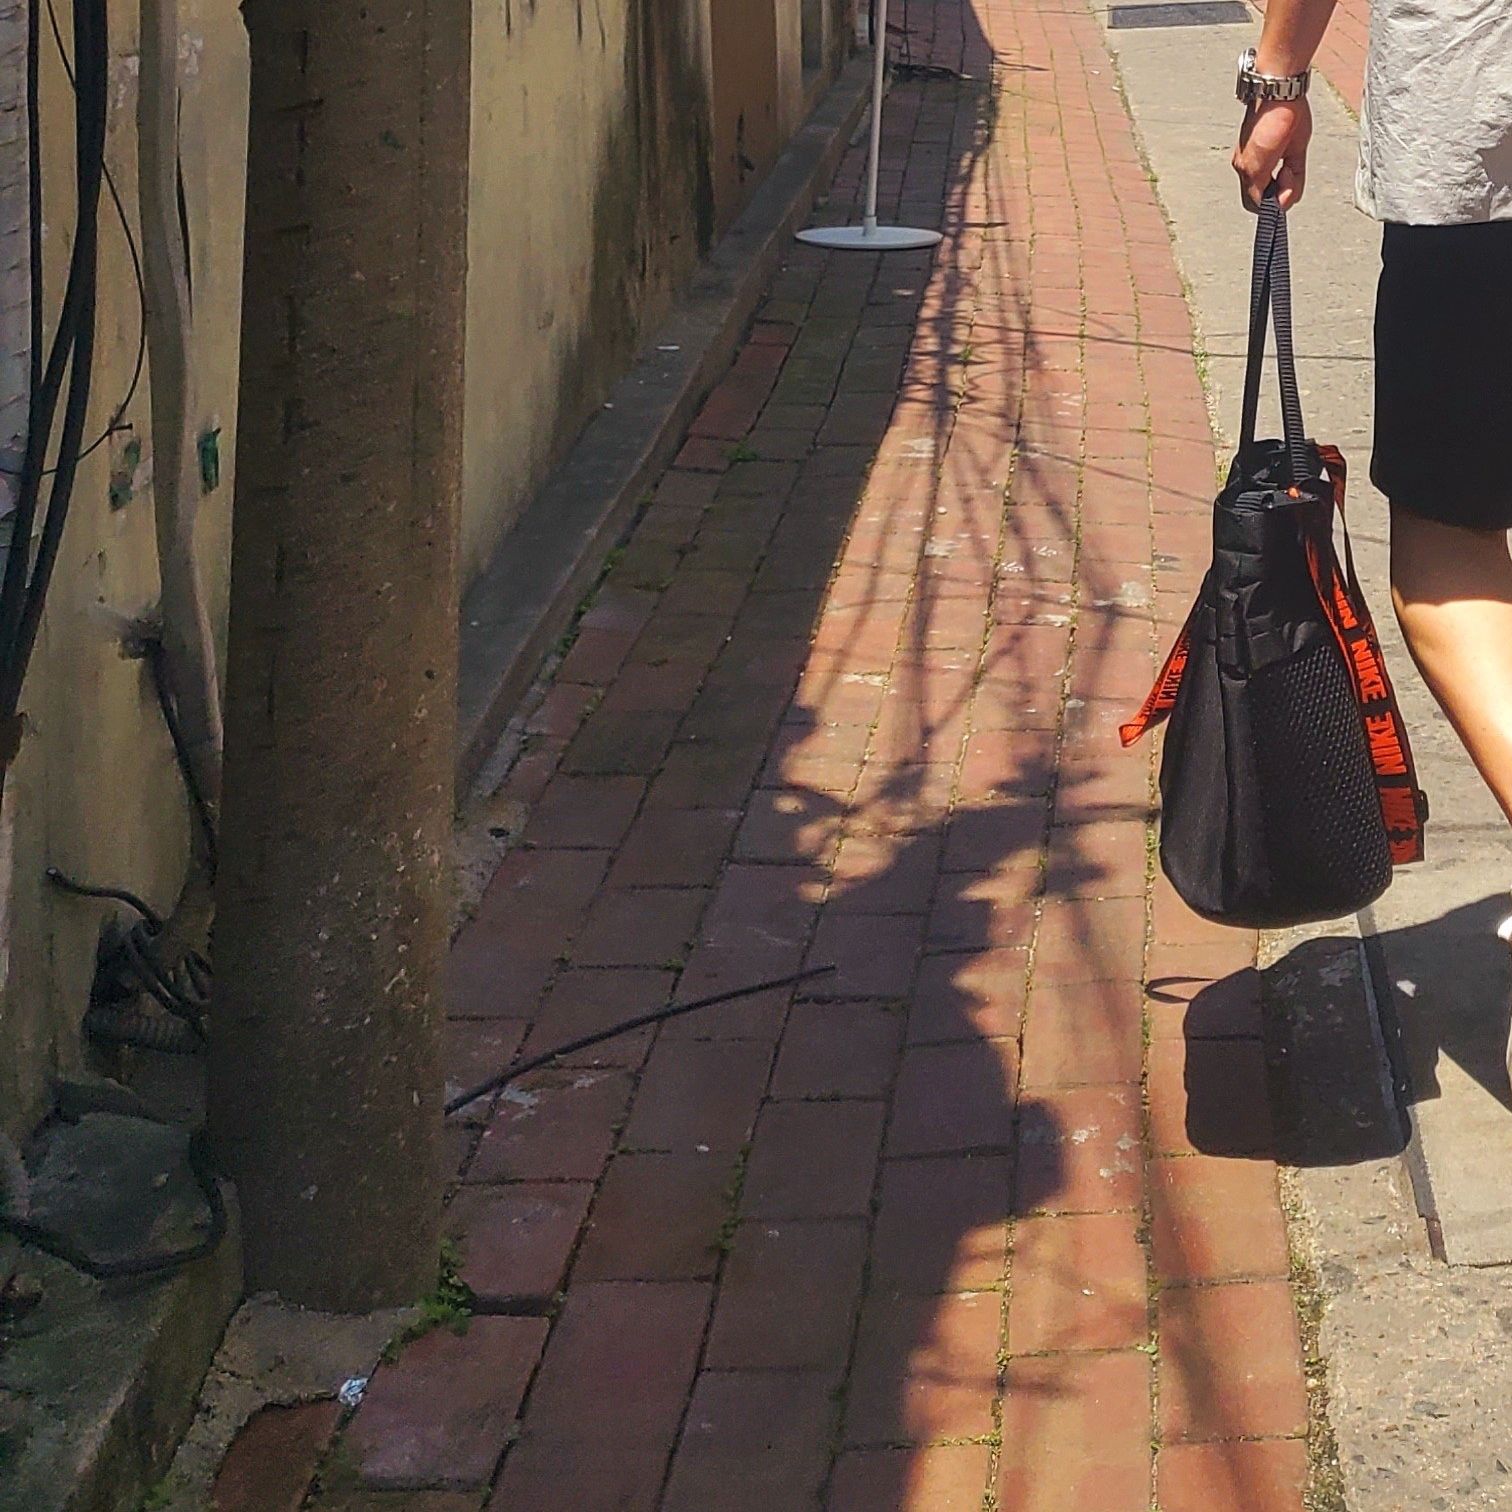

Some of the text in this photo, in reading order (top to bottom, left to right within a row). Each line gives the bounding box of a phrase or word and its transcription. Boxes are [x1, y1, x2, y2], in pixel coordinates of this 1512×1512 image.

[1159, 667, 1183, 700] NIKE
[1351, 638, 1387, 703] NIKE
[1366, 711, 1407, 776] NIKE
